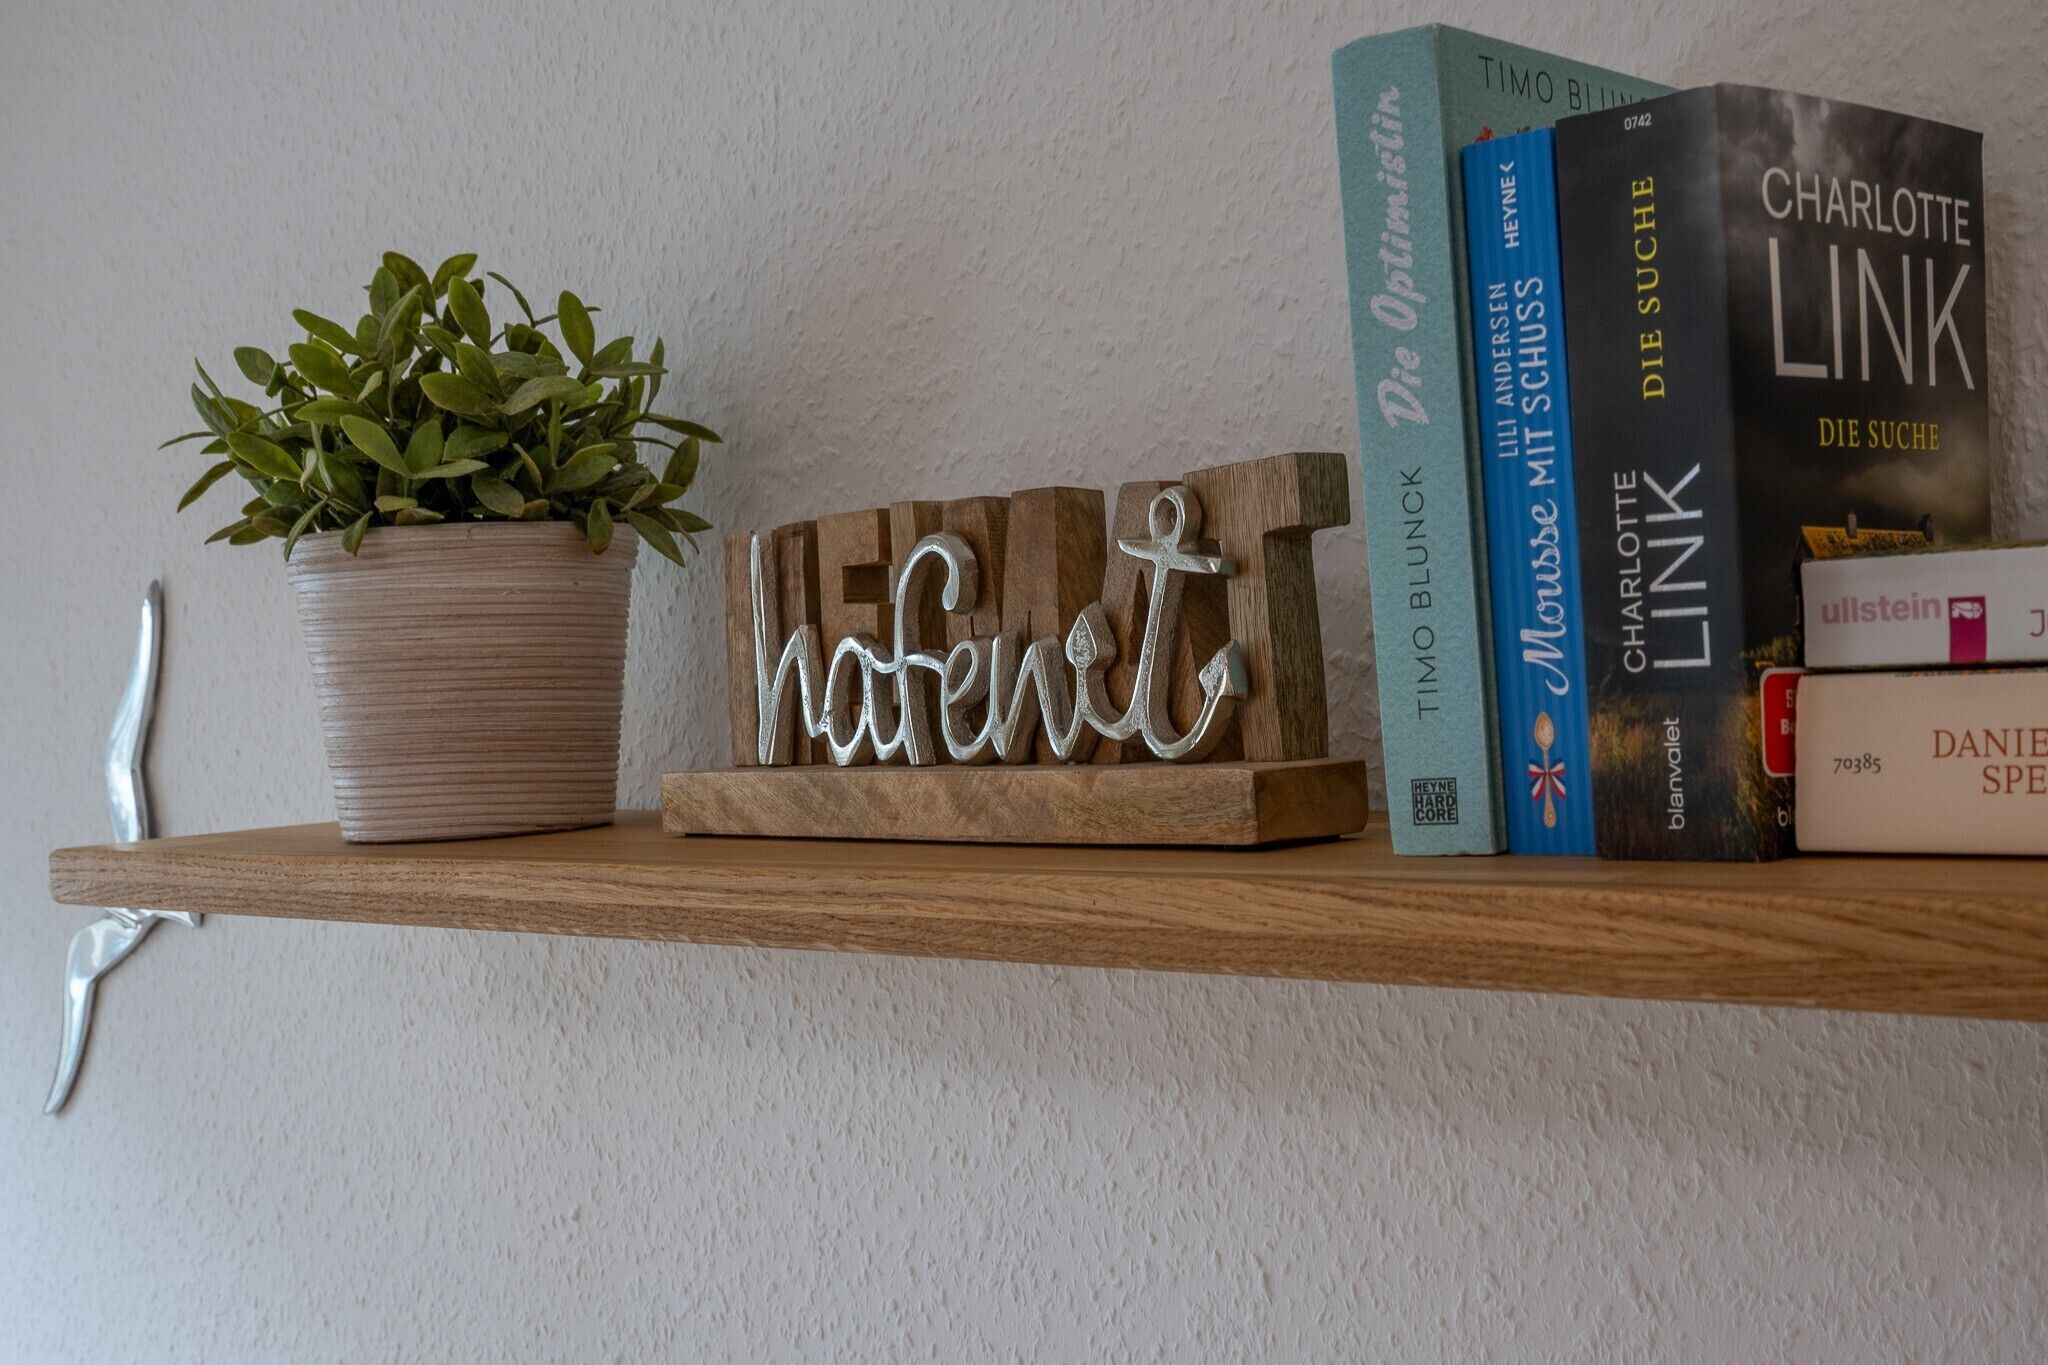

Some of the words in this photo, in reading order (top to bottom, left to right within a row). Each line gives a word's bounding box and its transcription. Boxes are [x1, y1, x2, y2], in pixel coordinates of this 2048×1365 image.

[1478, 54, 1554, 104] TIMO
[1624, 113, 1652, 131] 0742
[1369, 84, 1427, 332] Optimistin
[1502, 174, 1520, 248] HEYNE
[1631, 175, 1662, 315] SUCHE
[1762, 167, 1971, 247] CHARLOTTE
[1488, 282, 1515, 407] ANDERSEN
[1514, 276, 1552, 415] SCHUSS
[1768, 237, 1975, 391] LINK
[1376, 346, 1430, 428] Die
[1640, 330, 1665, 400] DIE
[1498, 419, 1519, 458] LILI
[1524, 427, 1556, 487] MIT
[1818, 417, 1860, 448] DIE
[1868, 419, 1940, 451] SUCHE
[1400, 466, 1432, 610] BLUNCK
[1613, 469, 1647, 674] CHARLOTTE
[1643, 463, 1712, 669] LINK
[1520, 498, 1569, 696] Mousse
[1821, 592, 1942, 625] ullstein
[1415, 625, 1440, 720] TIMO
[1414, 781, 1456, 792] HEYNE
[1415, 795, 1457, 808] HARD
[1664, 717, 1686, 830] blanvalet
[1833, 752, 1882, 774] 70385
[1982, 764, 2047, 795] SPE
[1415, 808, 1457, 821] CORE
